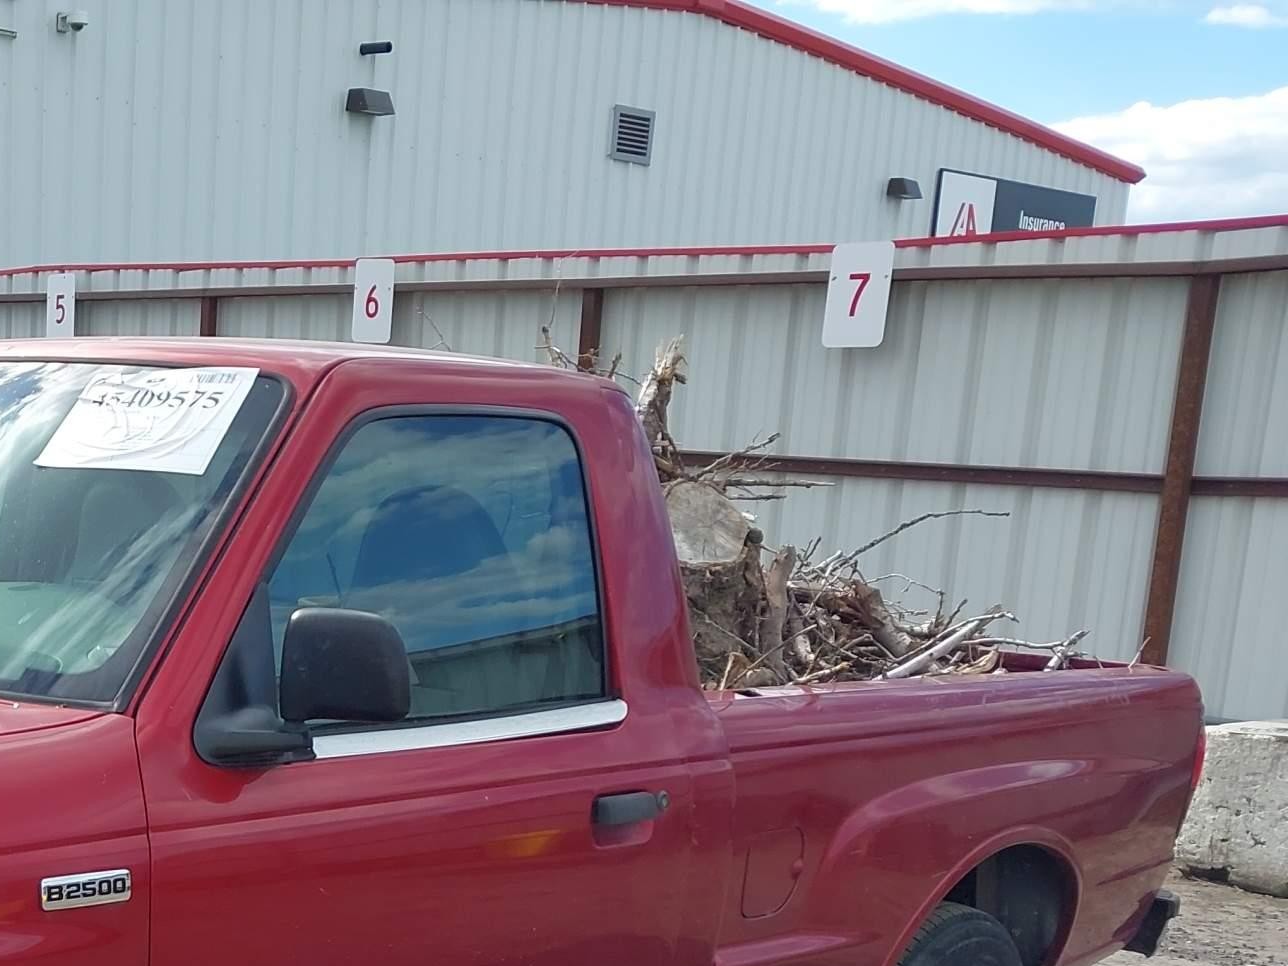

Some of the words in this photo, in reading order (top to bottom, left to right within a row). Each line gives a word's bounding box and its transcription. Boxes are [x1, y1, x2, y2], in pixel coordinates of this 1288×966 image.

[1019, 209, 1065, 231] Insurance
[55, 294, 65, 324] 5
[365, 284, 379, 318] 6
[849, 273, 870, 317] 7
[46, 877, 127, 902] B2500
